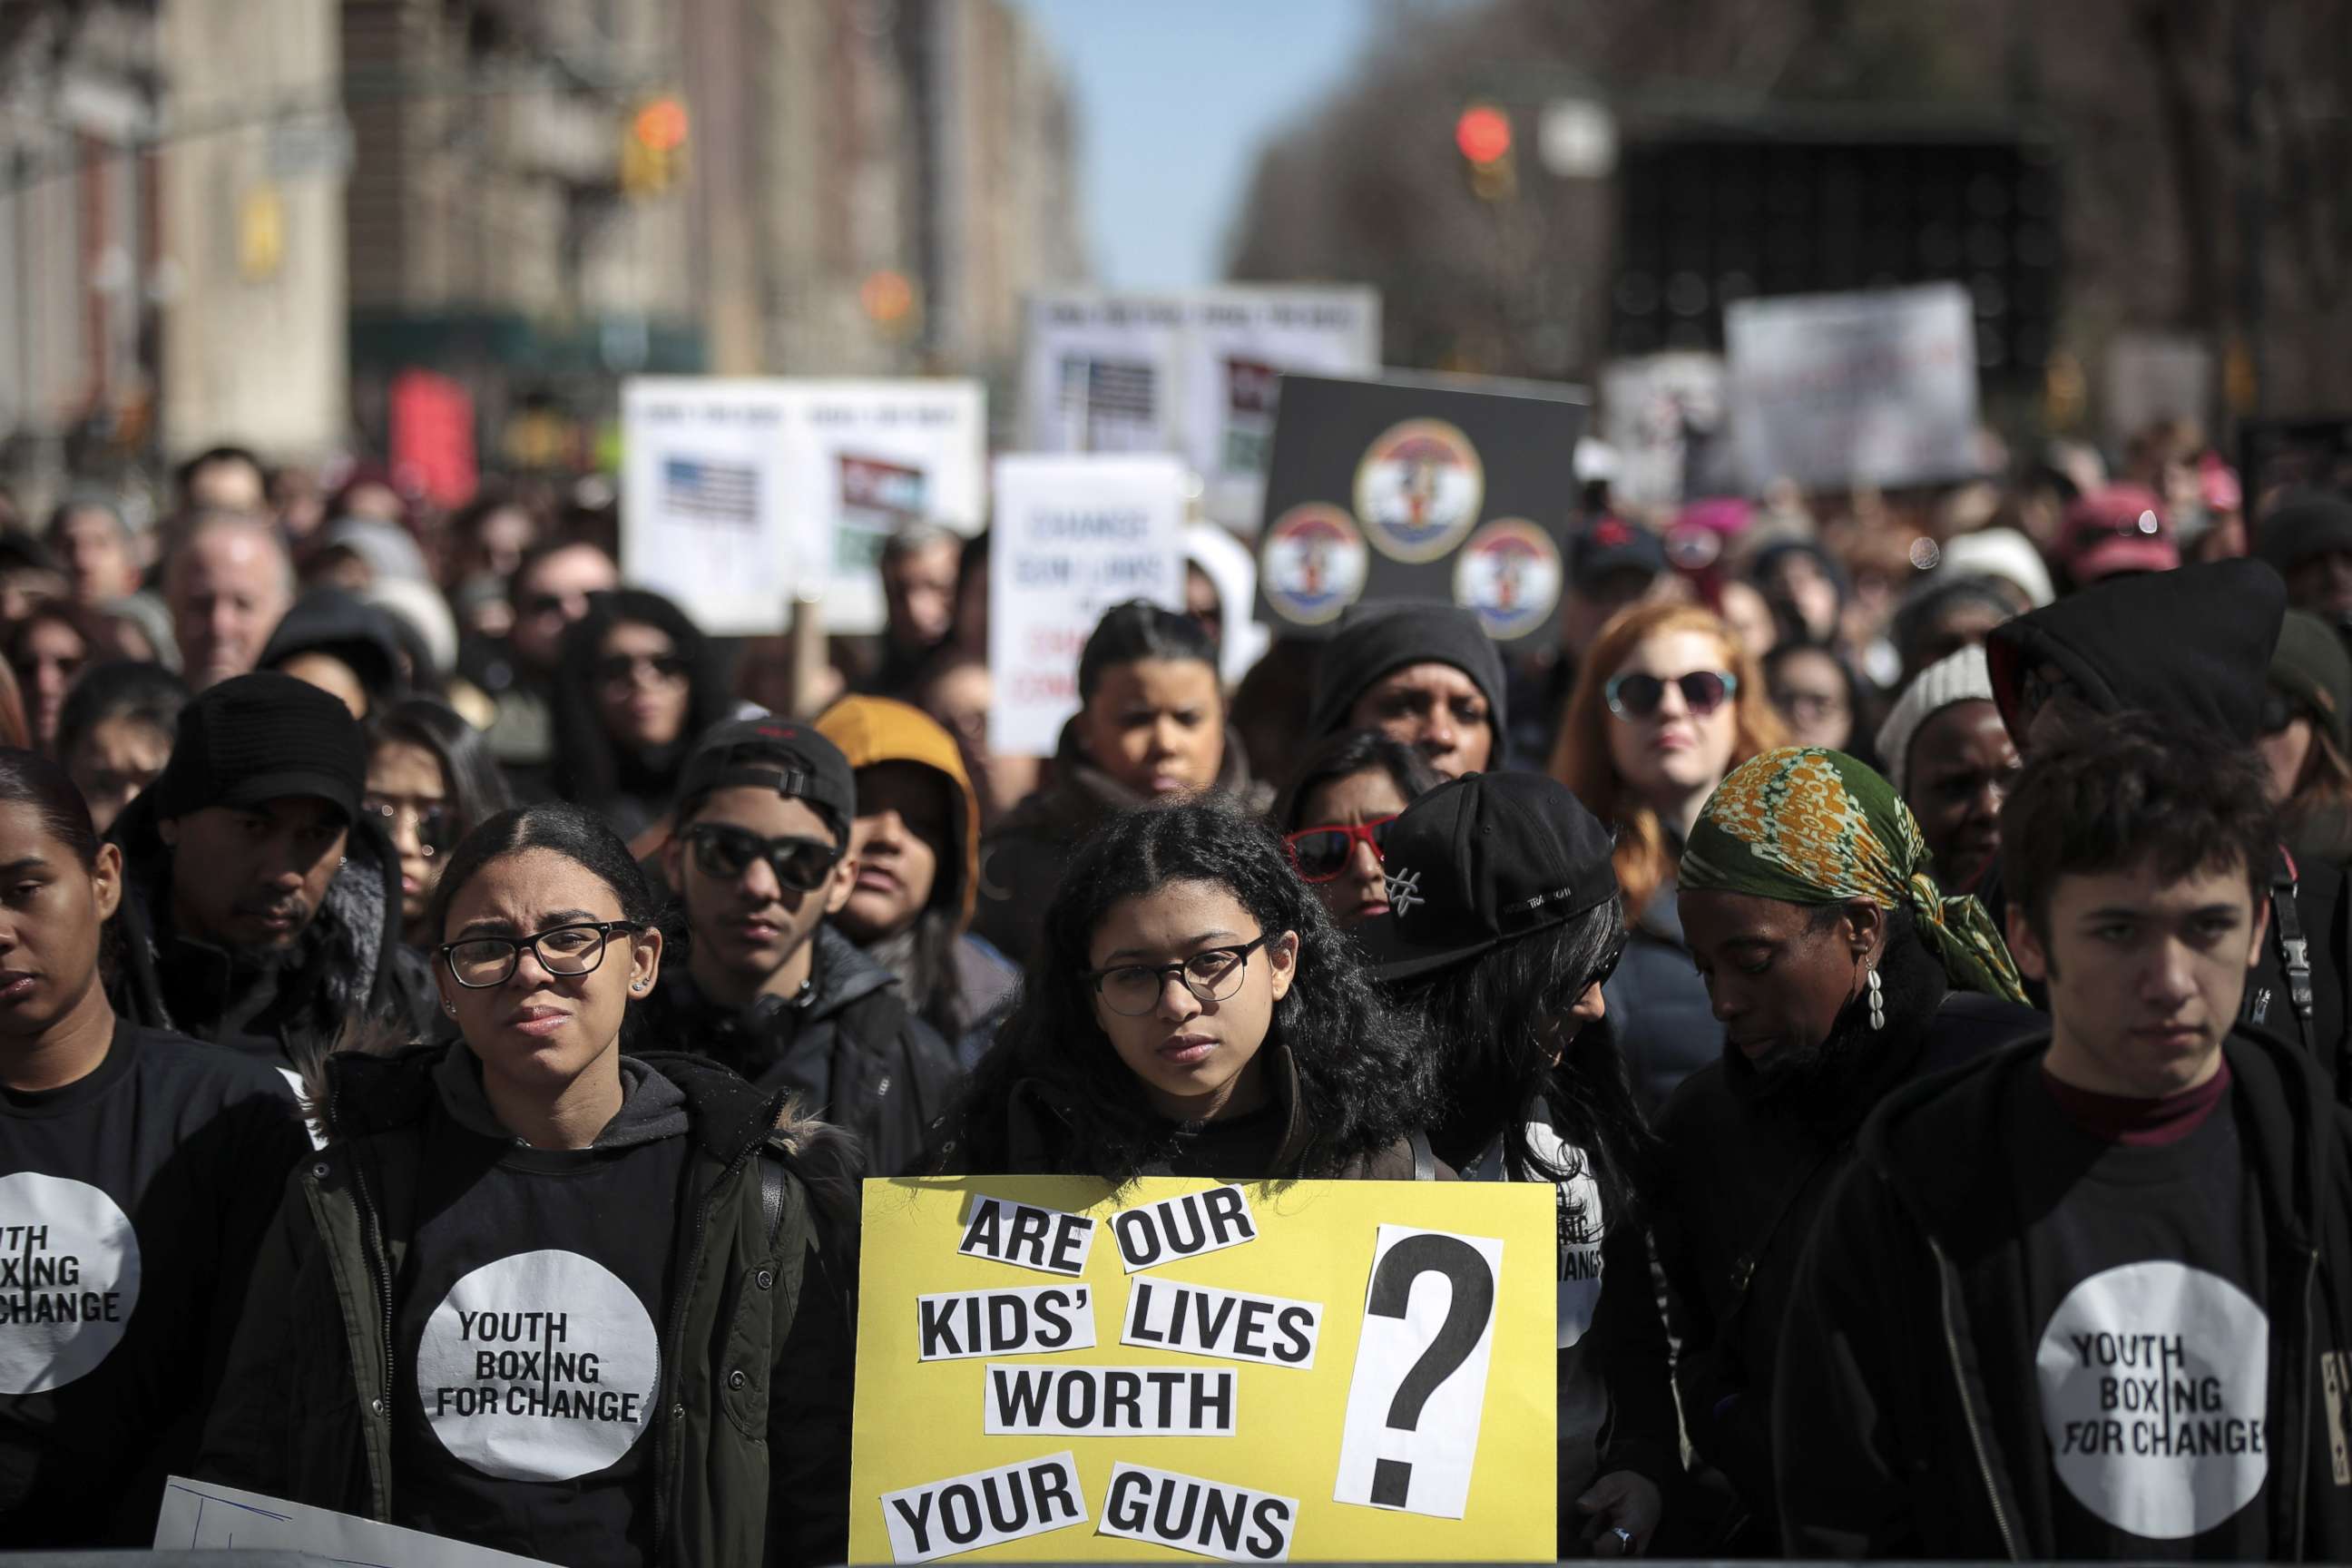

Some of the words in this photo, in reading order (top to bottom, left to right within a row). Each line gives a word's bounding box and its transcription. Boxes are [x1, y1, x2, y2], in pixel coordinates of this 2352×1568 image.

[959, 1200, 1094, 1272] ARE
[1115, 1187, 1255, 1265] OUR
[0, 1256, 80, 1287] XING
[458, 1311, 567, 1343] YOUTH
[921, 1289, 1088, 1356] KIDS'
[1130, 1283, 1315, 1363] LIVES
[475, 1350, 600, 1384] BOXING
[2071, 1332, 2185, 1367] YOUTH
[1367, 1233, 1494, 1507] ?
[436, 1387, 499, 1416] FOR
[505, 1387, 641, 1423] CHANGE
[994, 1369, 1232, 1429] WORTH
[2099, 1377, 2222, 1413] BOXING
[2063, 1421, 2124, 1455] FOR
[2132, 1419, 2264, 1456] CHANGE
[891, 1465, 1078, 1553] YOUR
[1107, 1471, 1290, 1560] GUNS
